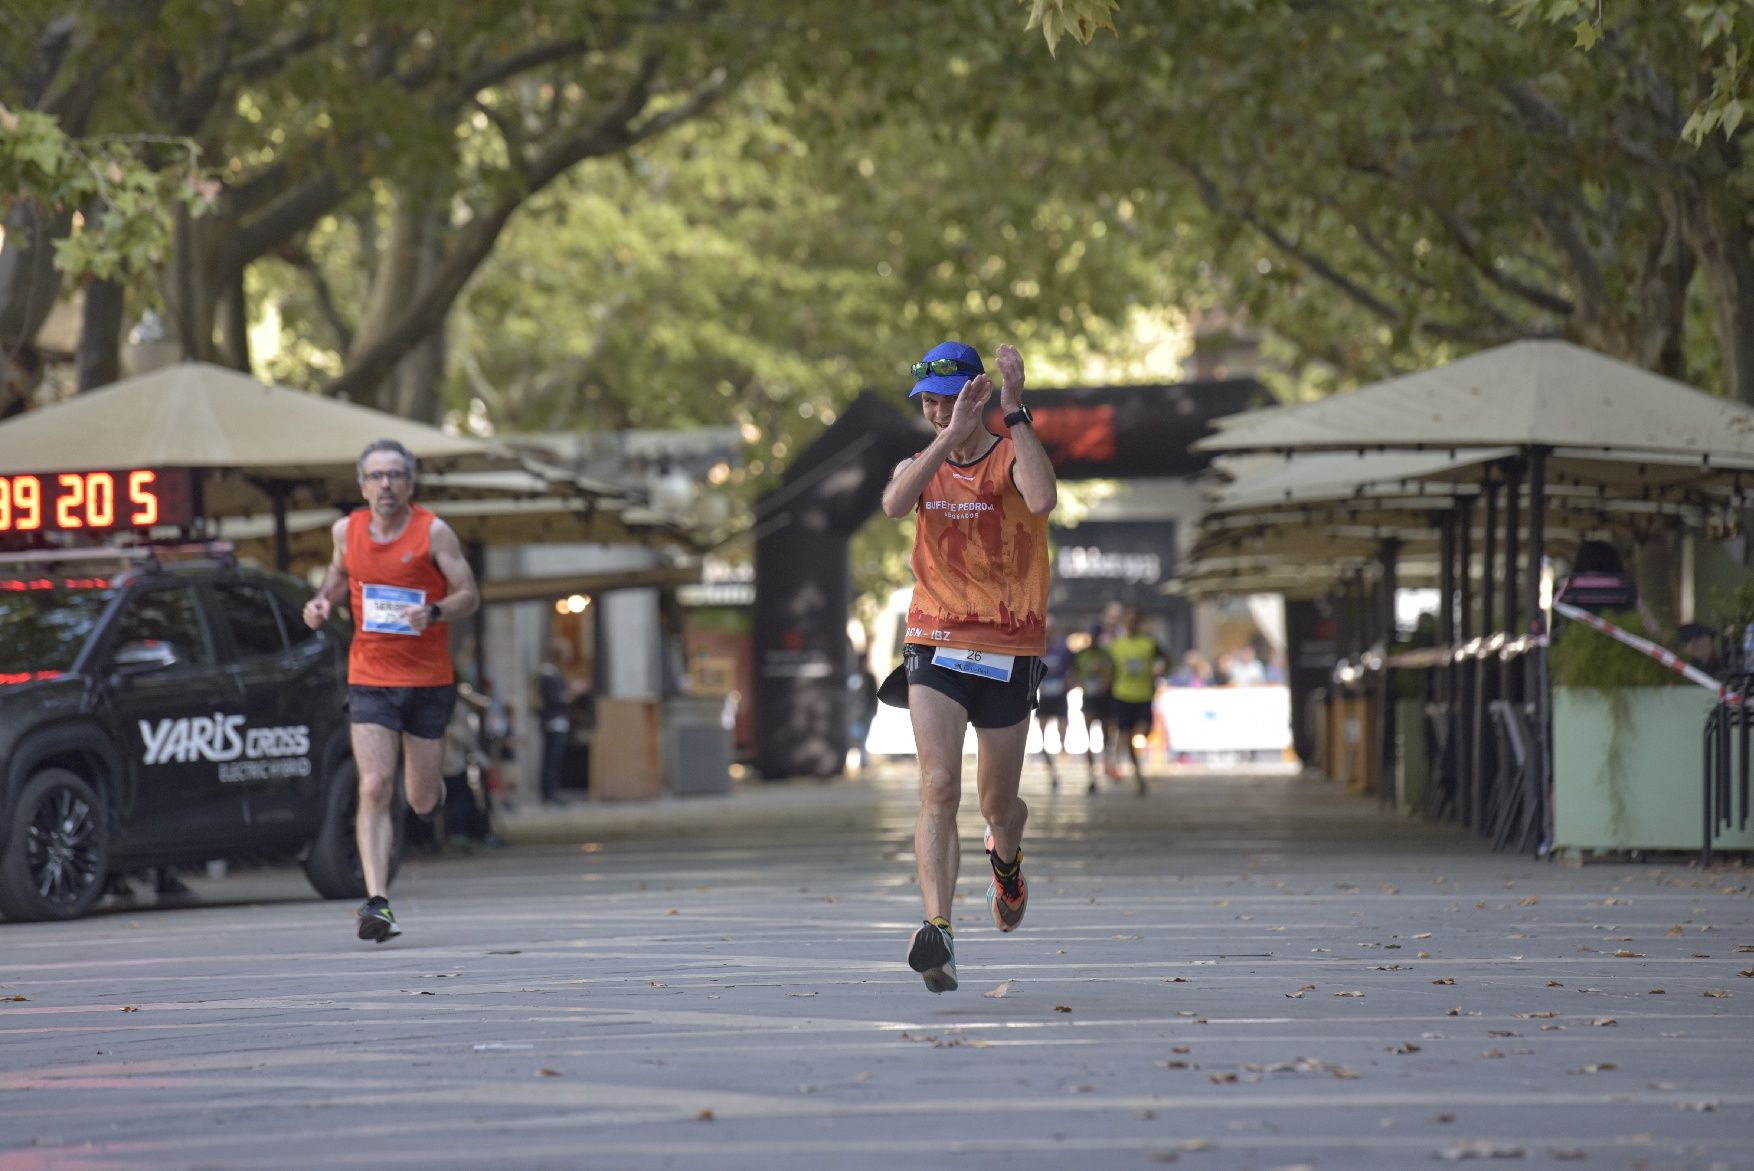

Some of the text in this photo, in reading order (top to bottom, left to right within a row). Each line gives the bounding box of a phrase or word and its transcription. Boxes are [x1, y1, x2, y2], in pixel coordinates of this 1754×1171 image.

[56, 472, 114, 528] 20
[128, 469, 158, 525] 5
[925, 500, 957, 512] BUFETE
[931, 630, 951, 641] IBZ
[967, 649, 982, 661] 26
[245, 724, 310, 758] CROSS
